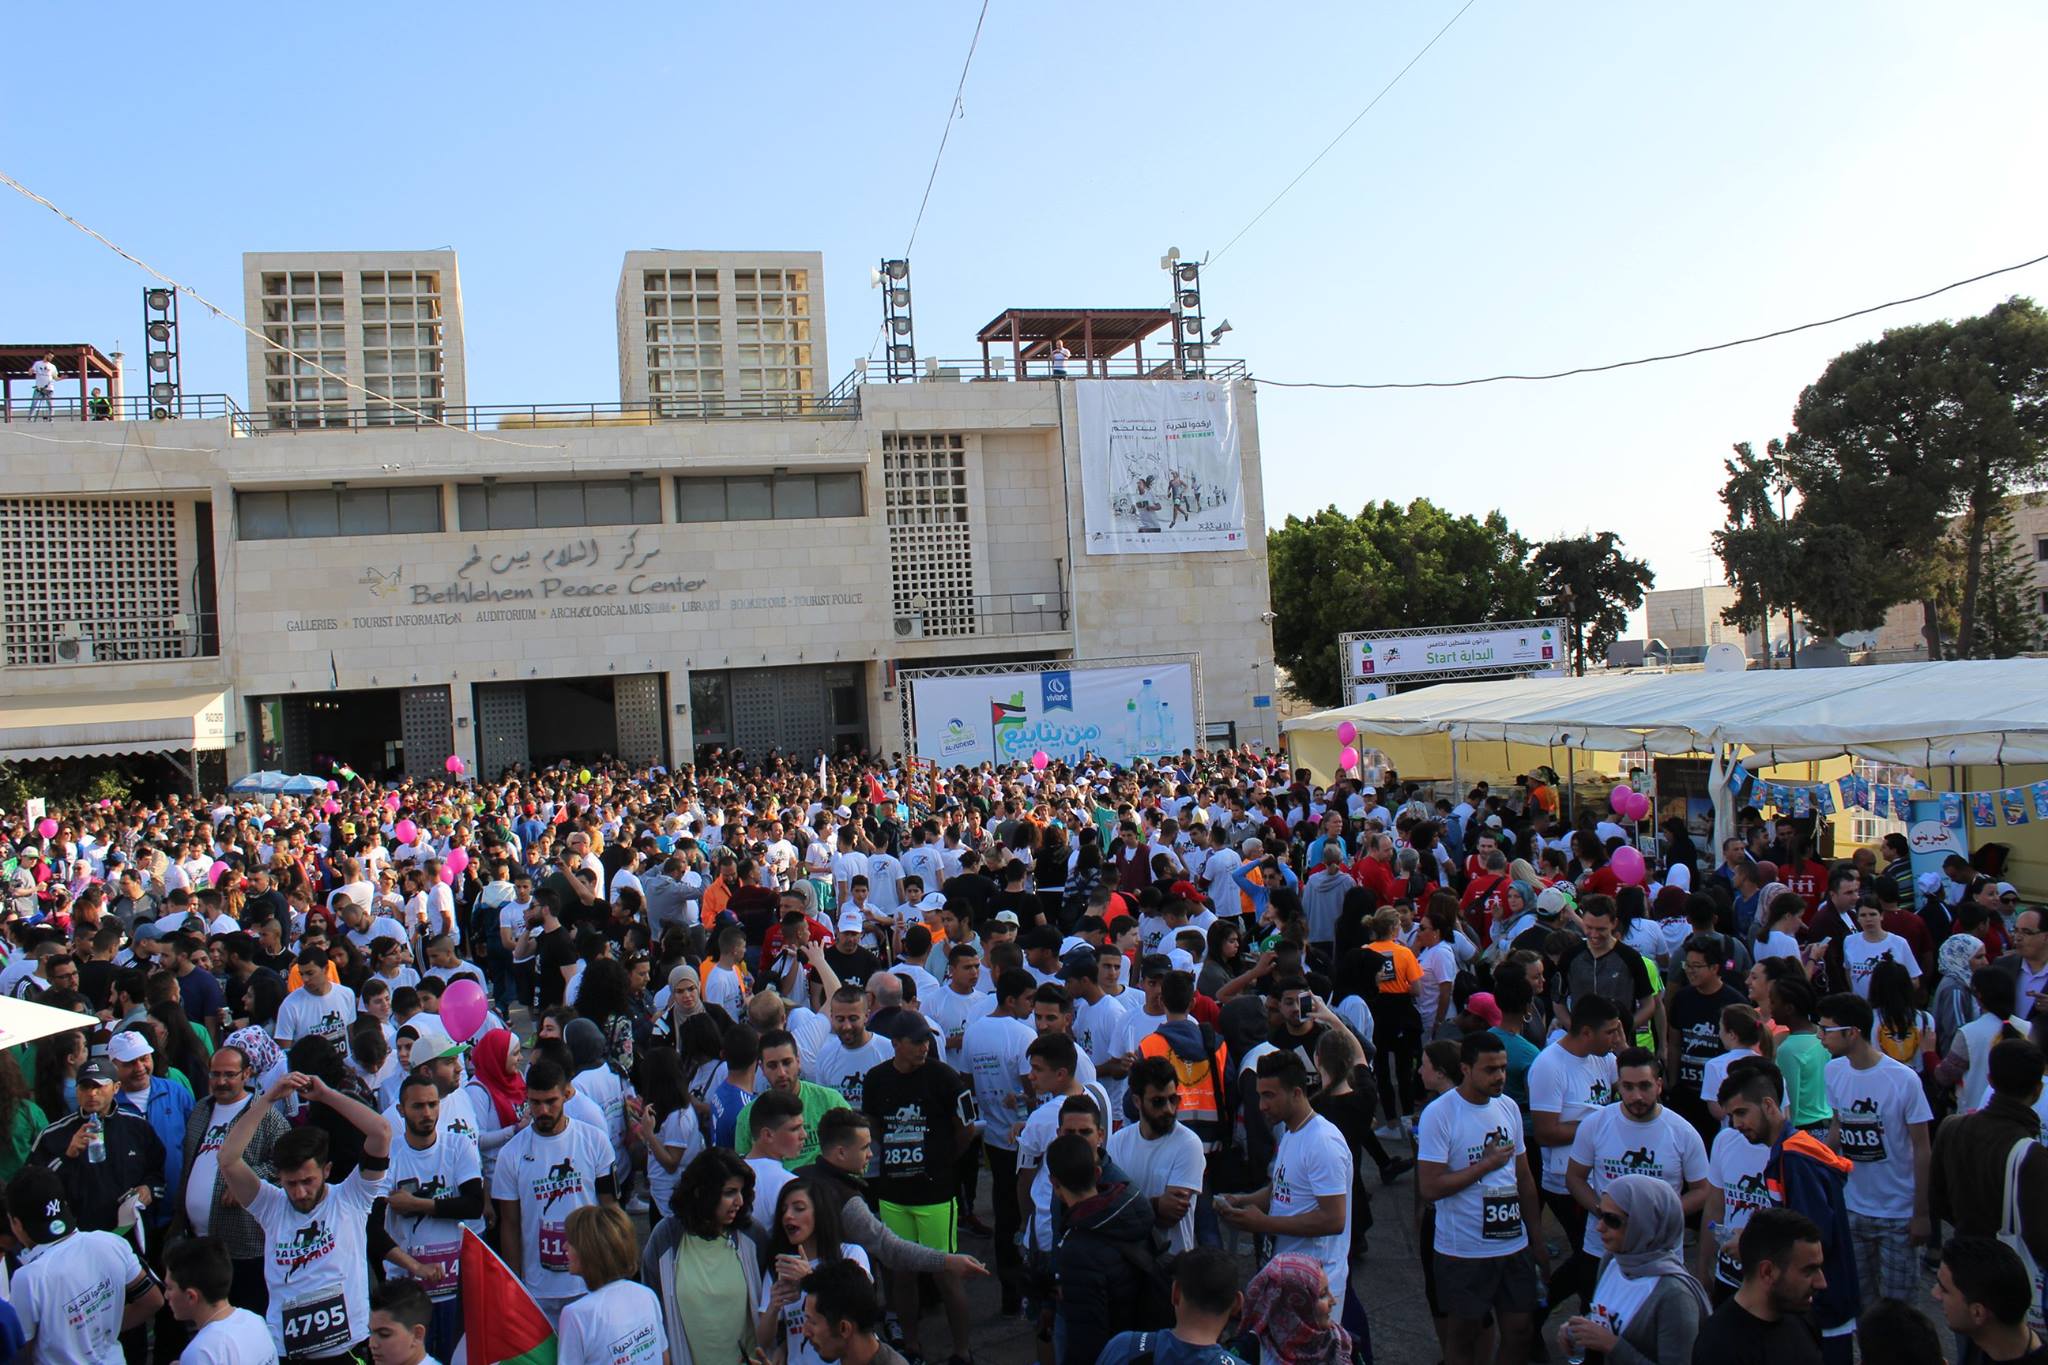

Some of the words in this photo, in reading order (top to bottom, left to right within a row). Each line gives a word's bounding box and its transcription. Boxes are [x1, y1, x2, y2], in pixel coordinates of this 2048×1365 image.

[542, 538, 600, 572] السلام
[614, 528, 661, 570] مركز
[490, 550, 531, 574] بيت
[409, 580, 533, 605] Bethlehem
[540, 577, 618, 599] Peace
[628, 574, 707, 596] Center
[286, 618, 338, 632] GALLERIES
[352, 616, 393, 629] TOURIST
[476, 608, 537, 623] AUDITORIUM
[681, 599, 720, 613] LIBRARY
[831, 592, 863, 606] POLICE
[1426, 651, 1457, 664] Start
[1460, 647, 1494, 664] البداية
[1003, 719, 1064, 754] ينابيع
[1064, 722, 1100, 746] من
[1839, 1128, 1880, 1146] 3018
[884, 1147, 924, 1165] 2826
[1604, 1164, 1663, 1177] PALESTINE
[1485, 1201, 1520, 1222] 3648
[284, 1304, 346, 1339] 4795
